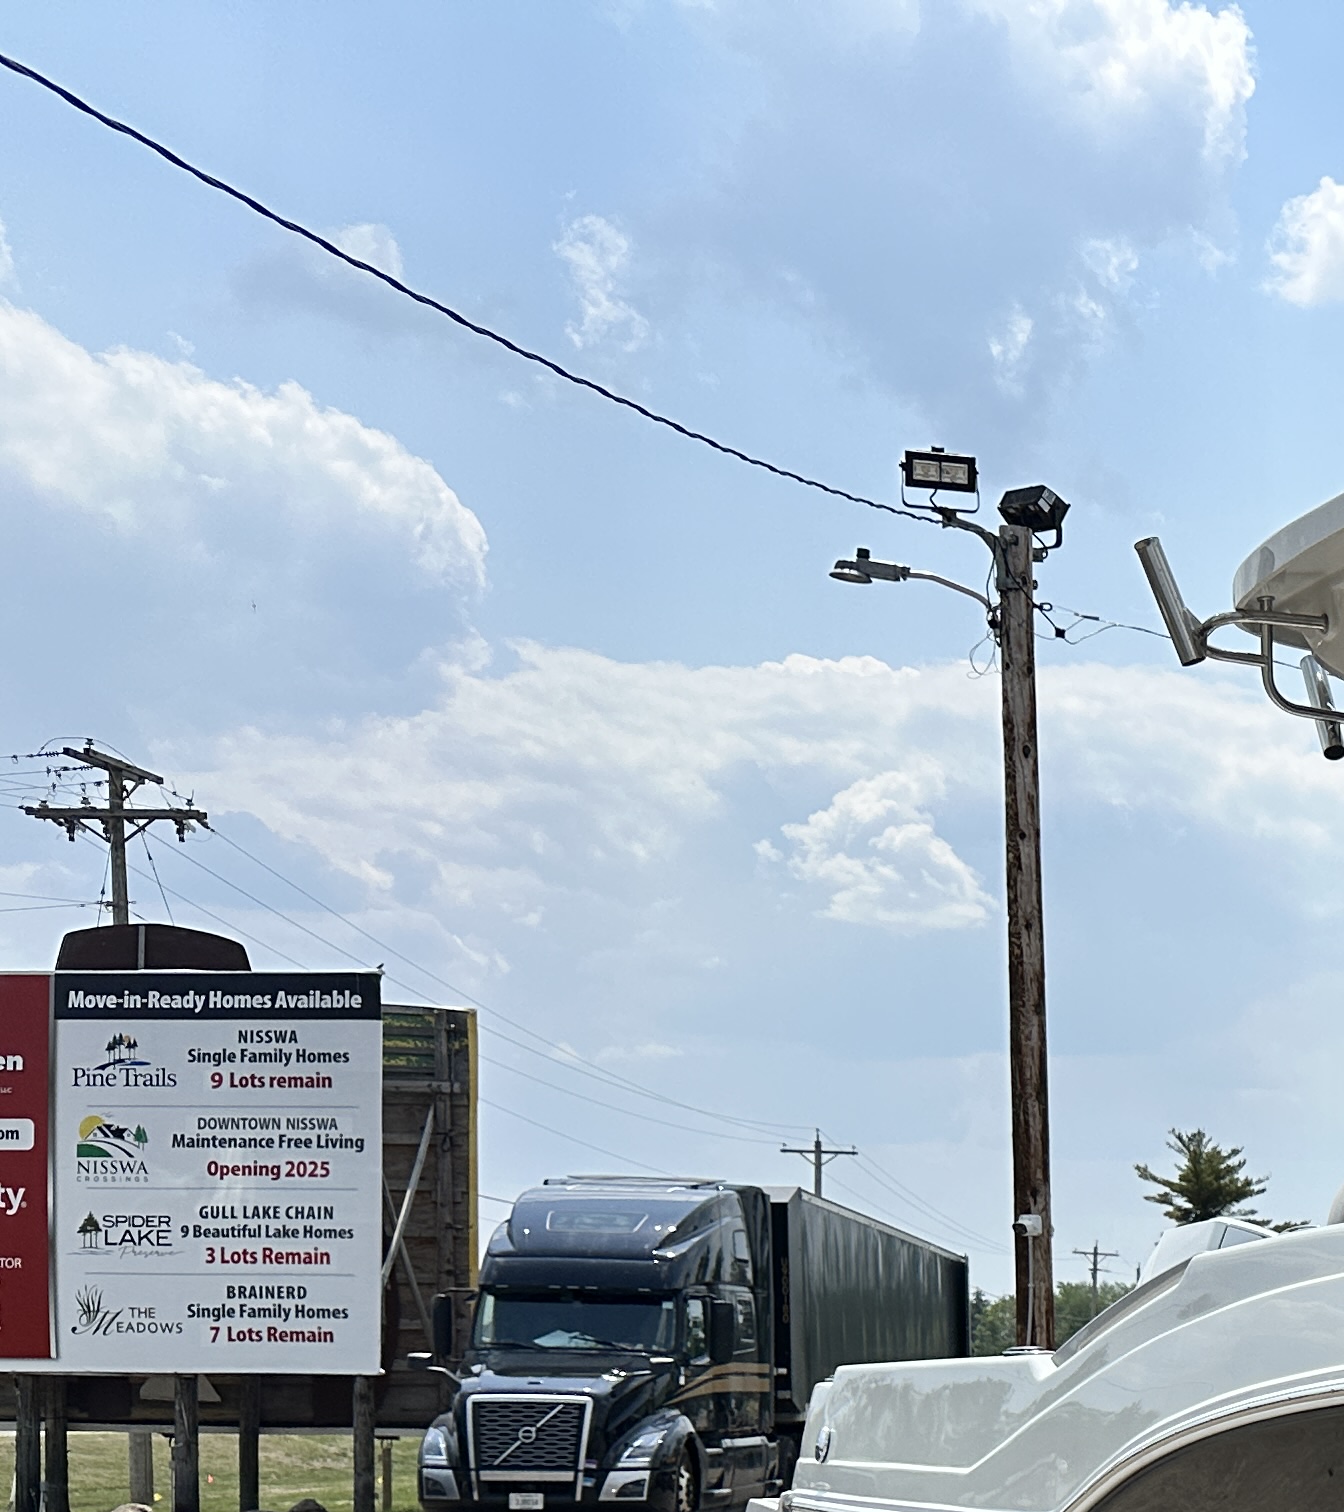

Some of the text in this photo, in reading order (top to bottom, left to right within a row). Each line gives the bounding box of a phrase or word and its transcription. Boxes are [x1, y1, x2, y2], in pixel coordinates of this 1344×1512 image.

[68, 990, 362, 1013] Move-in-Ready Homes Available
[238, 1030, 298, 1044] NISSWA
[187, 1048, 350, 1067] Single Family Homes
[72, 1067, 177, 1087] Pine Trails
[210, 1072, 332, 1089] 9 Lots remain
[197, 1117, 338, 1130] DOWNTOWN NISSWA
[171, 1133, 365, 1153] Maintenance Free Living
[77, 1160, 149, 1175] NISSWA
[207, 1160, 331, 1181] Opening 2025
[198, 1205, 334, 1220] GULL LAKE CHAIN
[102, 1215, 171, 1228] SPIDER
[104, 1229, 172, 1246] LAKE
[180, 1224, 354, 1239] 9 Beautiful Lake Homes
[205, 1247, 331, 1265] 3 Lots Remain
[226, 1285, 307, 1300] BRAINERD
[128, 1307, 156, 1319] THE
[187, 1303, 349, 1323] Single Family Homes
[209, 1326, 334, 1343] 7 Lots Remain
